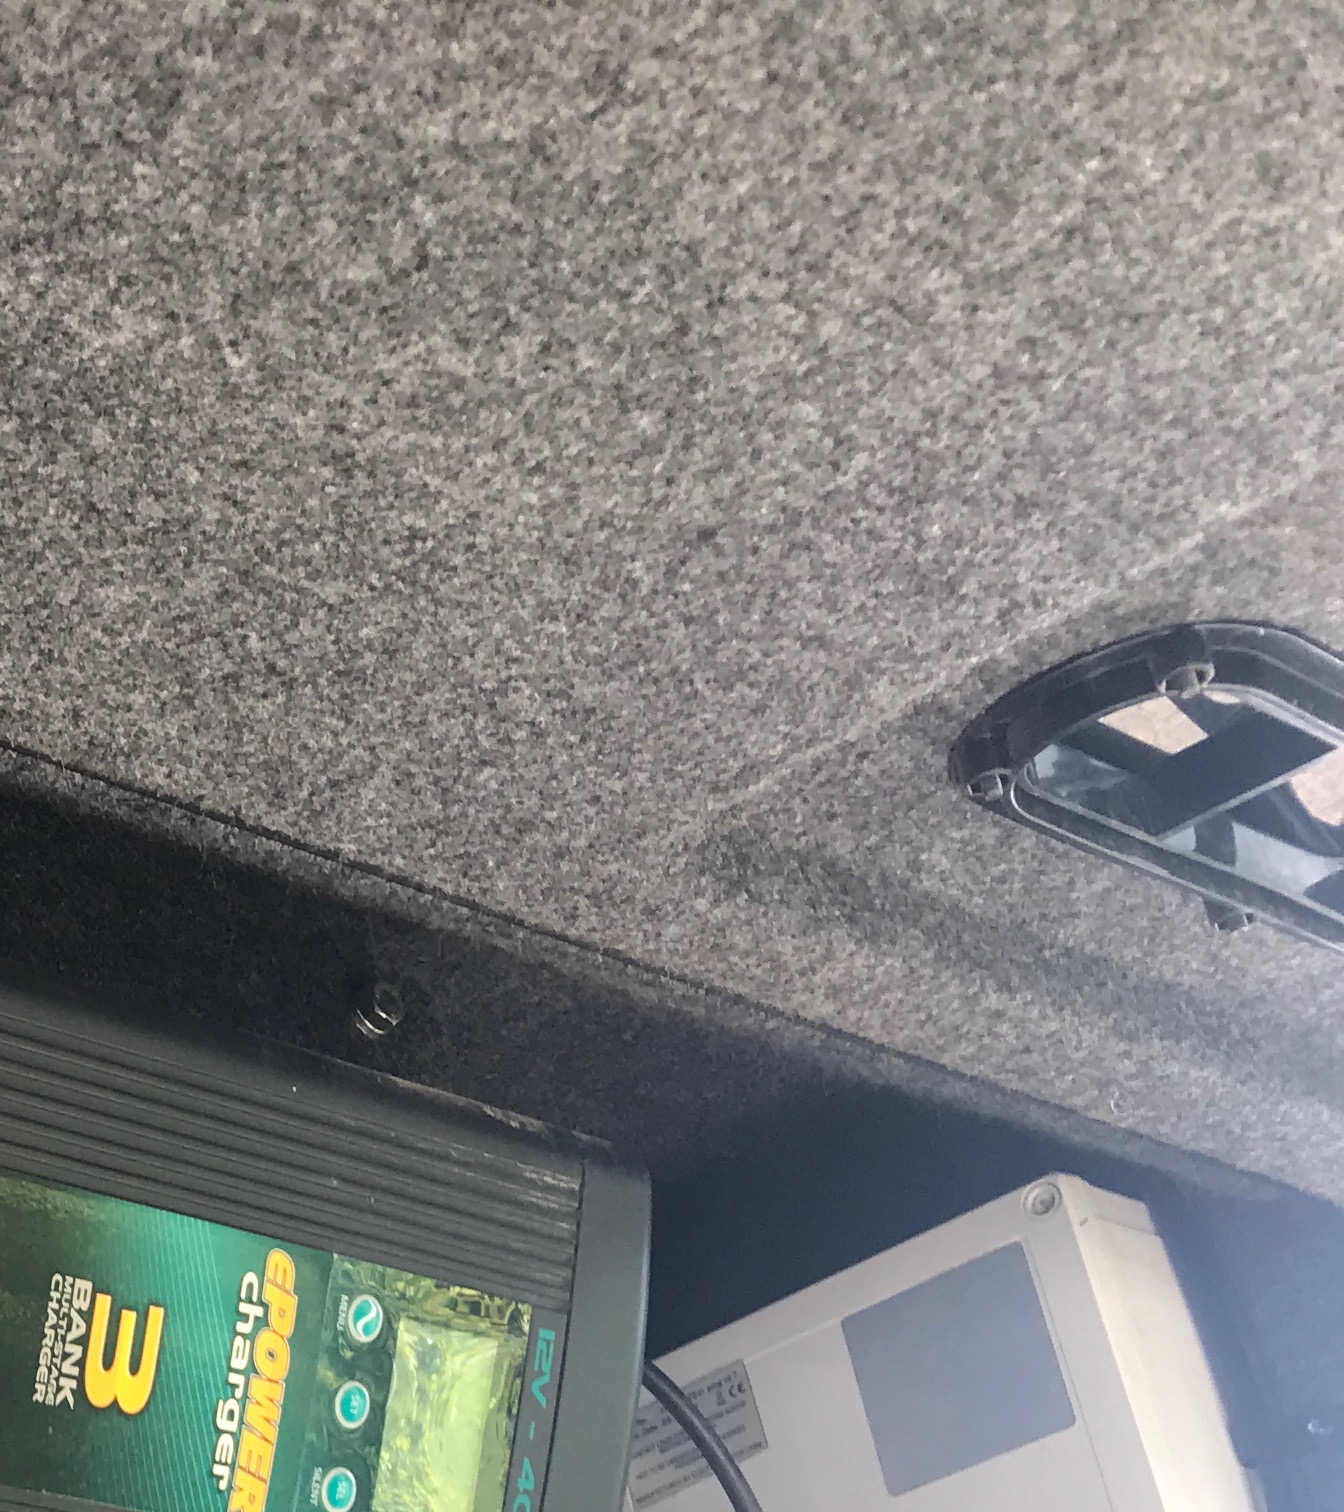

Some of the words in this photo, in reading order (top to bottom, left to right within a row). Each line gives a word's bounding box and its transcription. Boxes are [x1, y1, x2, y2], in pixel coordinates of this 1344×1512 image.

[31, 1272, 63, 1403] CHARGER
[45, 1275, 75, 1407] MULTI-STAGE
[55, 1276, 94, 1411] BANK
[84, 1292, 165, 1415] 3
[336, 1294, 350, 1331] MENU
[531, 1326, 556, 1409] 12V
[212, 1271, 264, 1492] charger
[349, 1393, 361, 1416] SET
[335, 1479, 348, 1500] SEL
